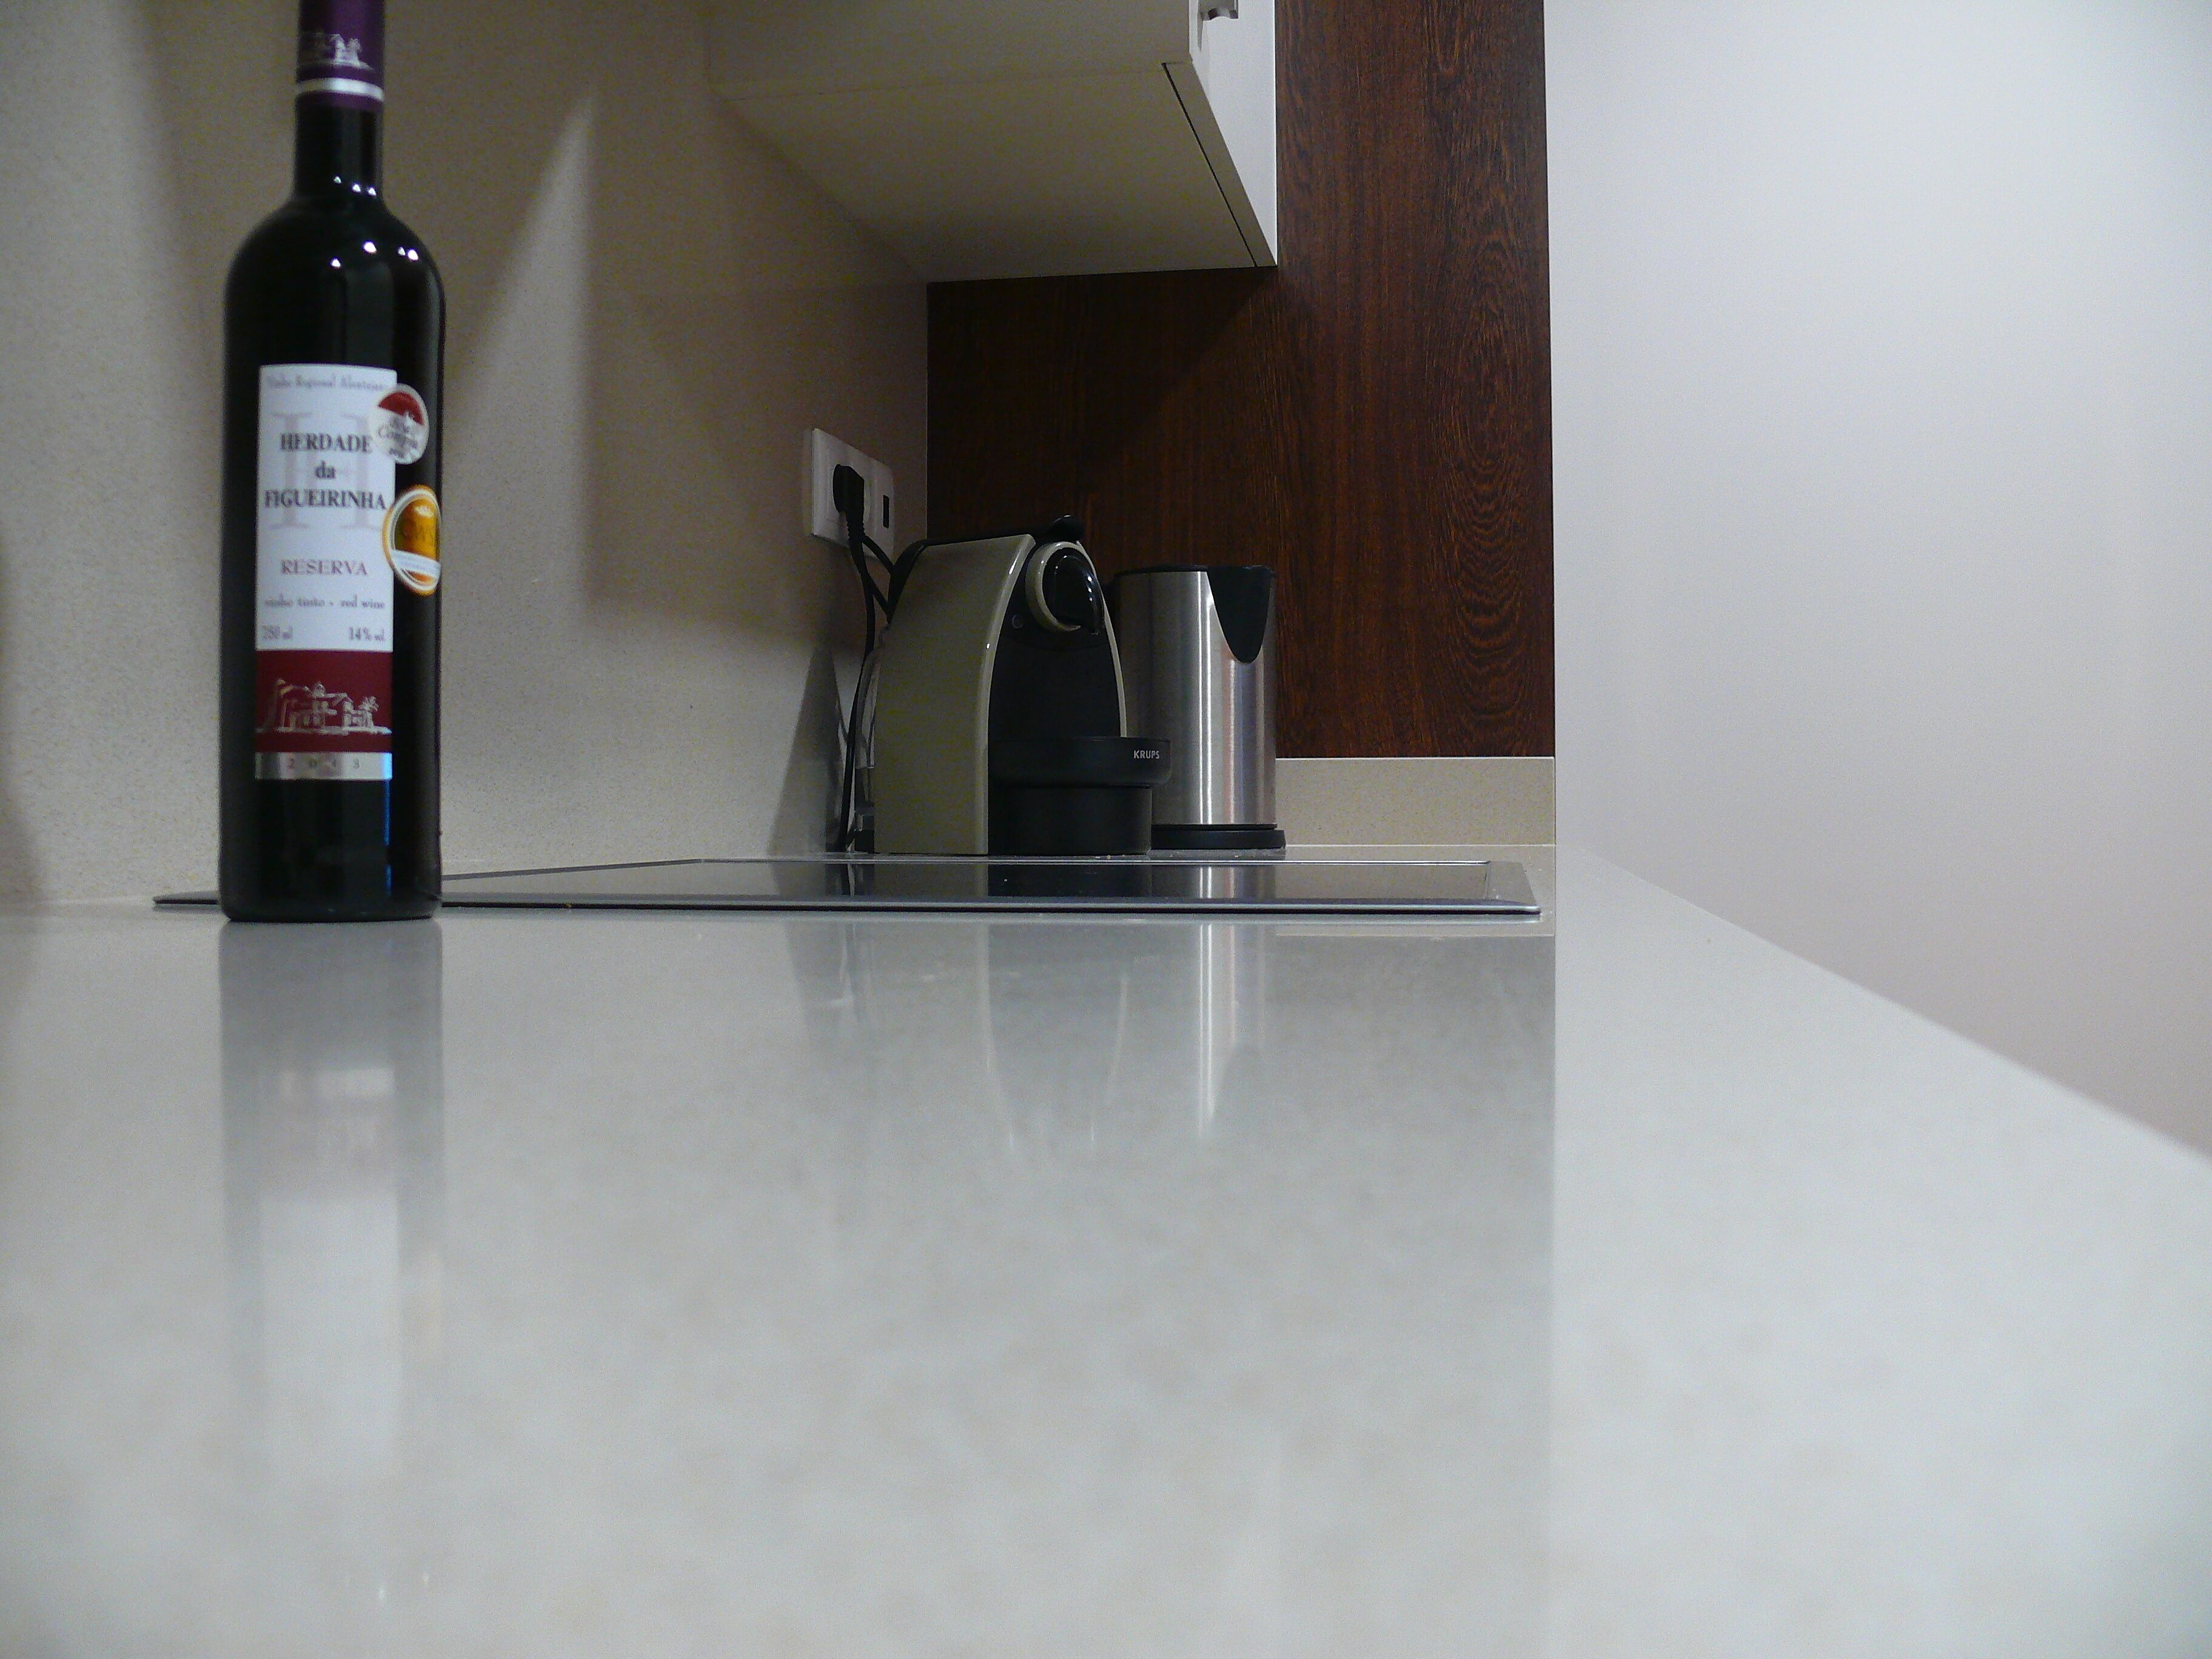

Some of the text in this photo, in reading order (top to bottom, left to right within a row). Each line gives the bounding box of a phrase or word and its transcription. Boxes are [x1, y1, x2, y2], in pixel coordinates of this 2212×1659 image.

[280, 433, 372, 452] HERDADE
[315, 461, 337, 480] da
[264, 489, 388, 511] FIGUEIRINHA
[281, 558, 367, 575] RESERVA
[340, 594, 358, 607] red
[361, 598, 385, 609] wine
[1133, 749, 1159, 759] KRUPS
